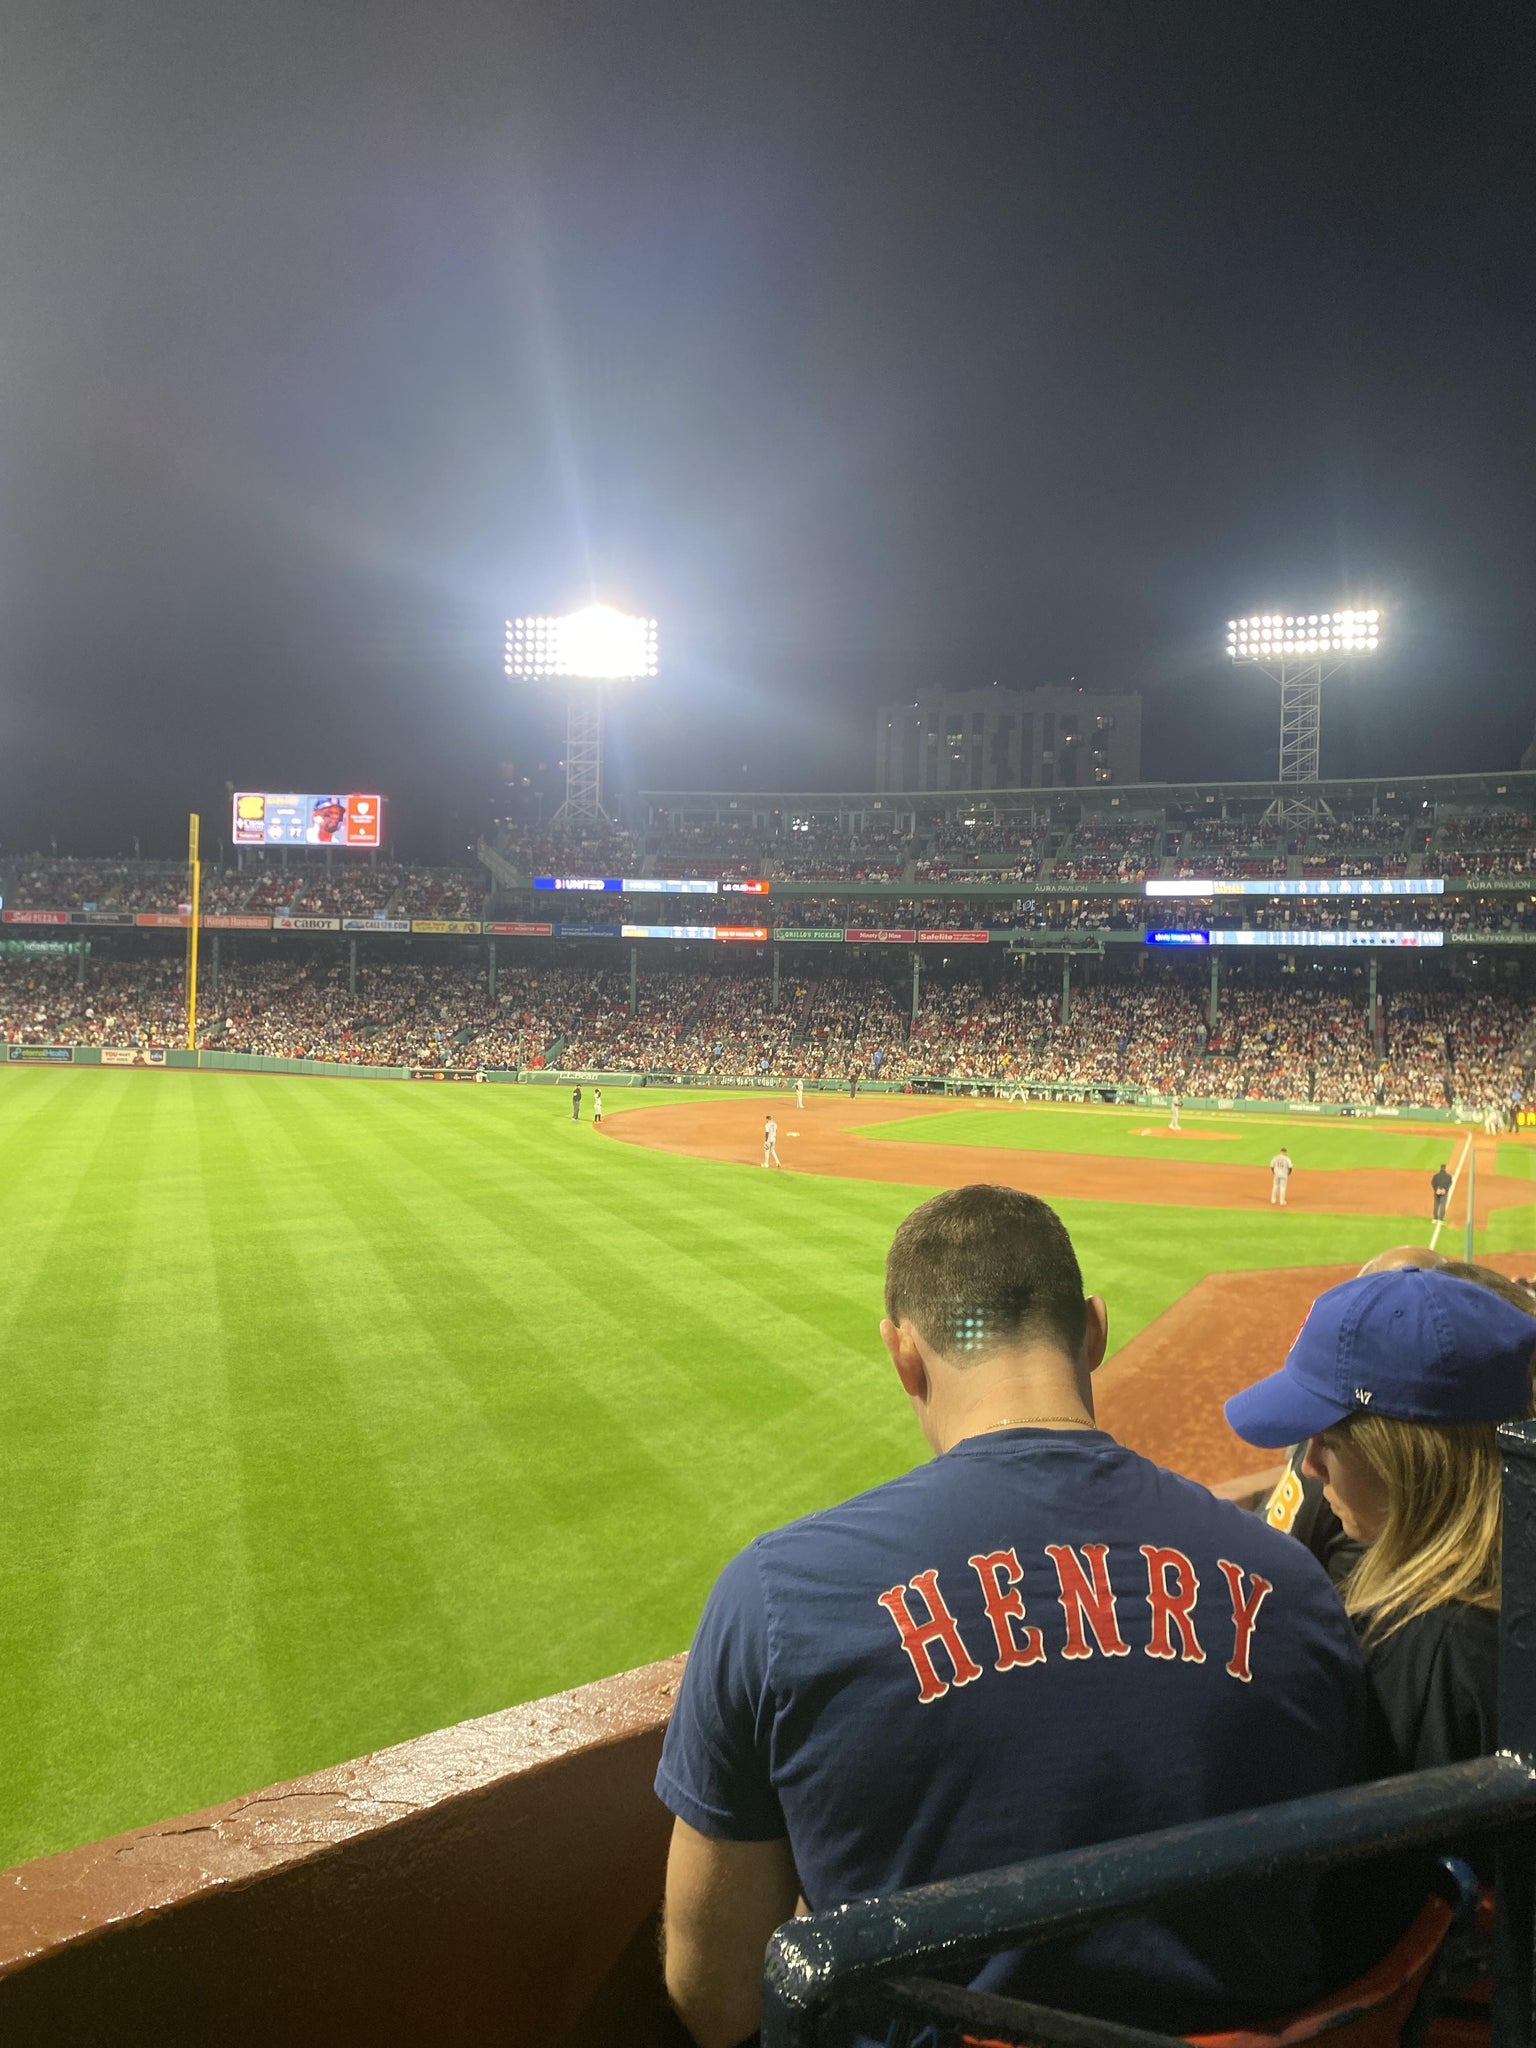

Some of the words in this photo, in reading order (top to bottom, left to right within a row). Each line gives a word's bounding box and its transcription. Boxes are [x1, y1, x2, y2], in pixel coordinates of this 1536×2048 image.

[565, 879, 605, 890] UNITED
[1493, 881, 1530, 889] PAVILION
[920, 933, 953, 941] Safelite
[877, 1544, 1273, 1704] HENRY
